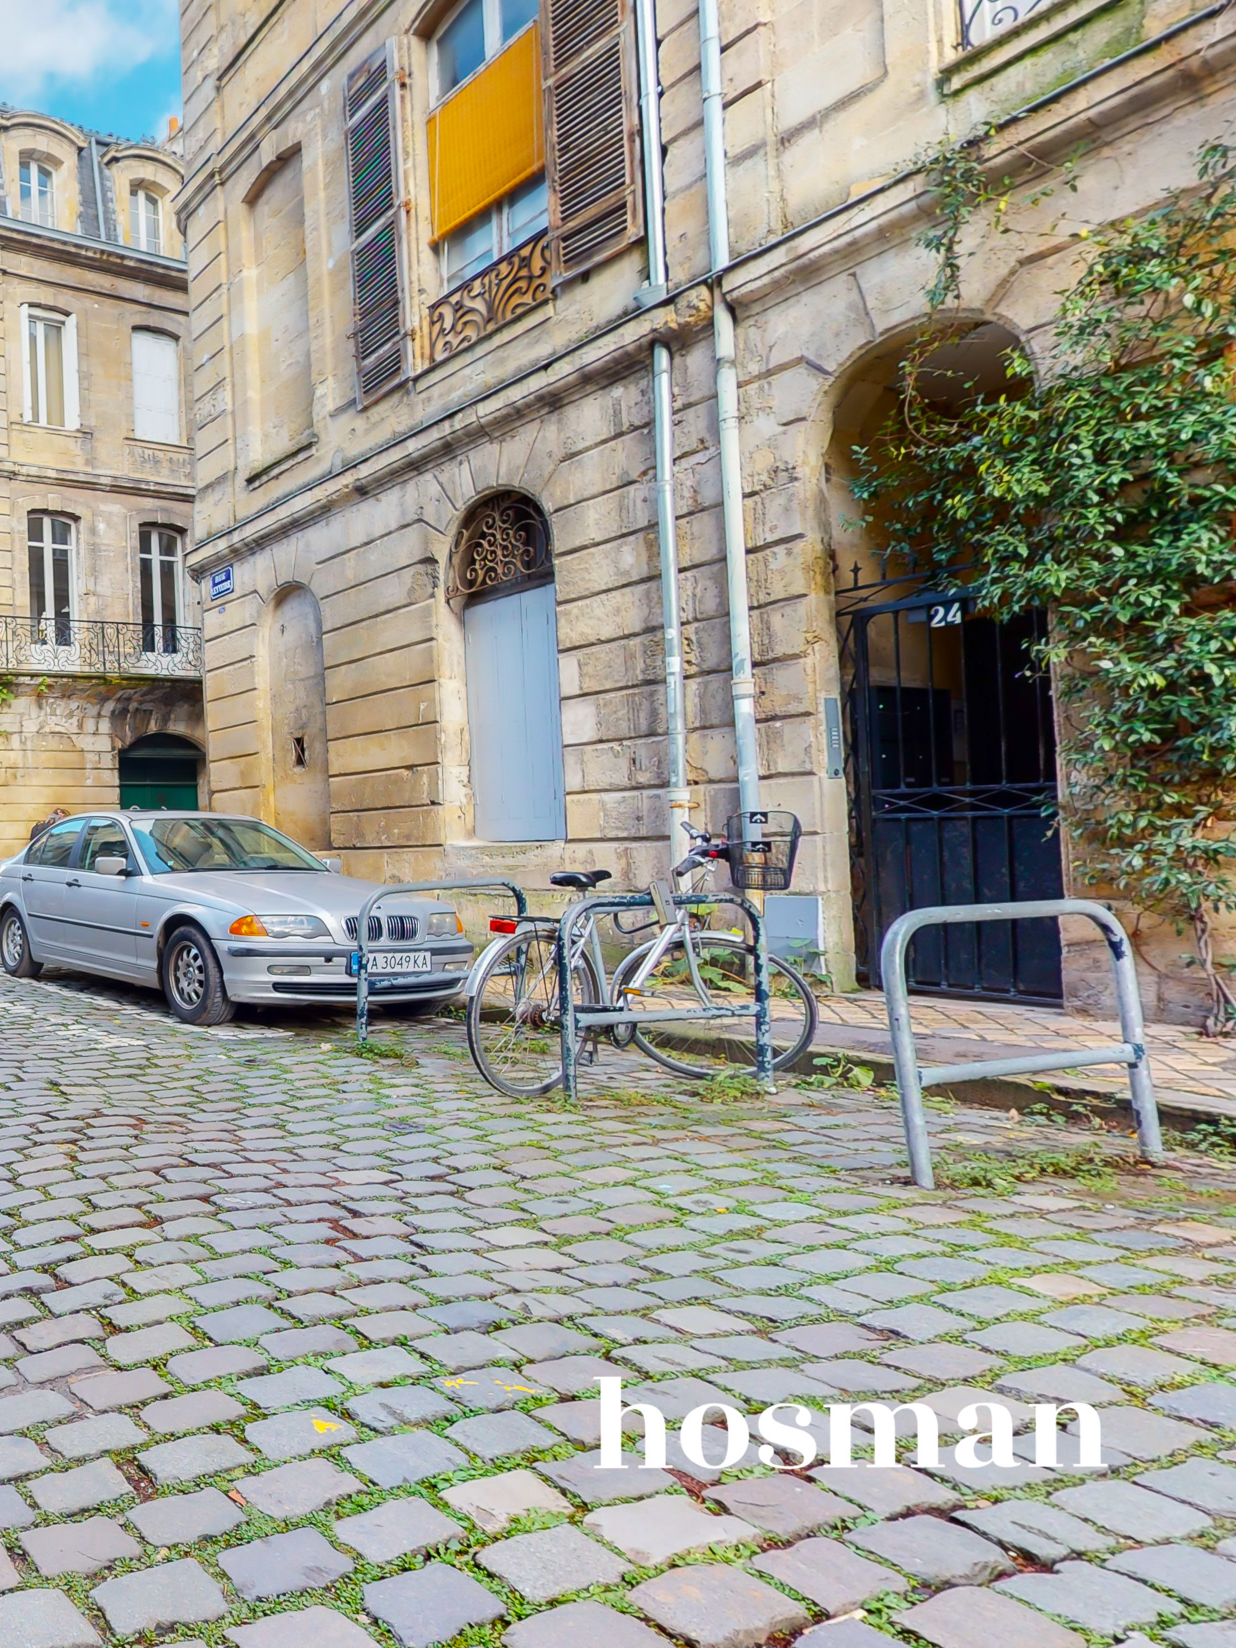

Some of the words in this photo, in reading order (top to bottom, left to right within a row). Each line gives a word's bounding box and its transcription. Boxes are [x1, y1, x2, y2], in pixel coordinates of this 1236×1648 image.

[930, 602, 962, 628] 24
[381, 955, 411, 970] 3049
[413, 954, 428, 969] KA
